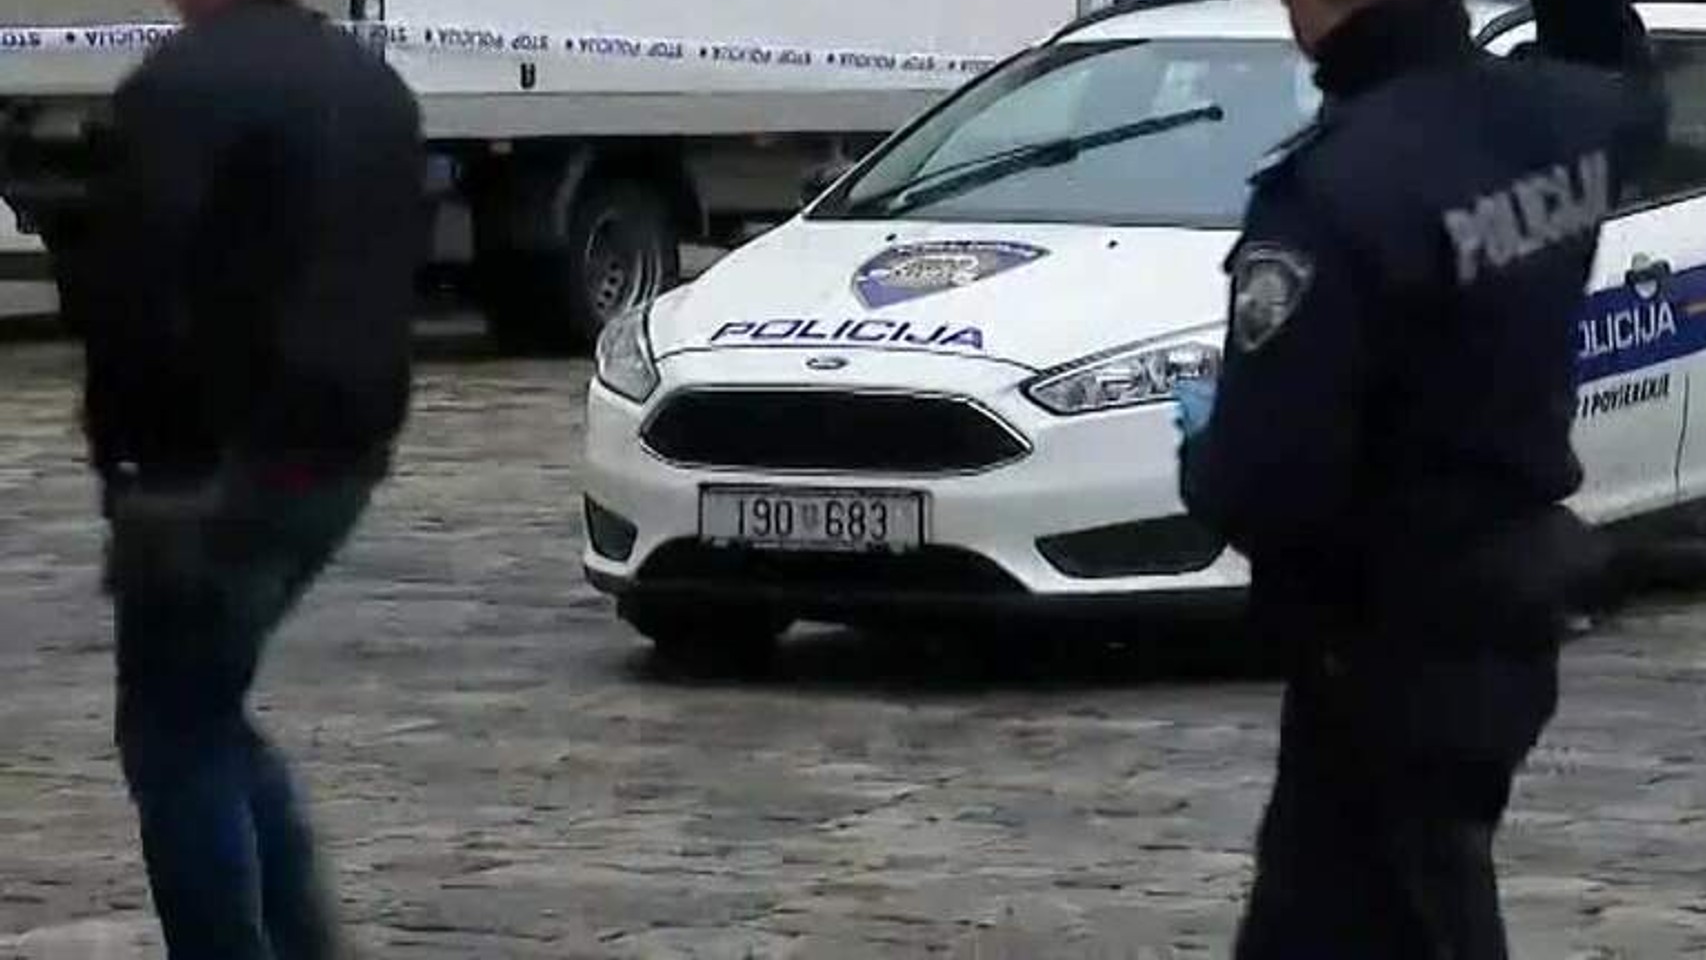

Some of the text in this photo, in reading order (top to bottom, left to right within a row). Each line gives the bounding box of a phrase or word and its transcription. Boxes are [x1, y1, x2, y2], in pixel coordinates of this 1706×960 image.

[0, 31, 41, 47] STO
[511, 35, 549, 51] STOP
[711, 320, 984, 349] POLICIJA
[1578, 300, 1676, 358] OLICIJA
[738, 498, 887, 540] 190 683
